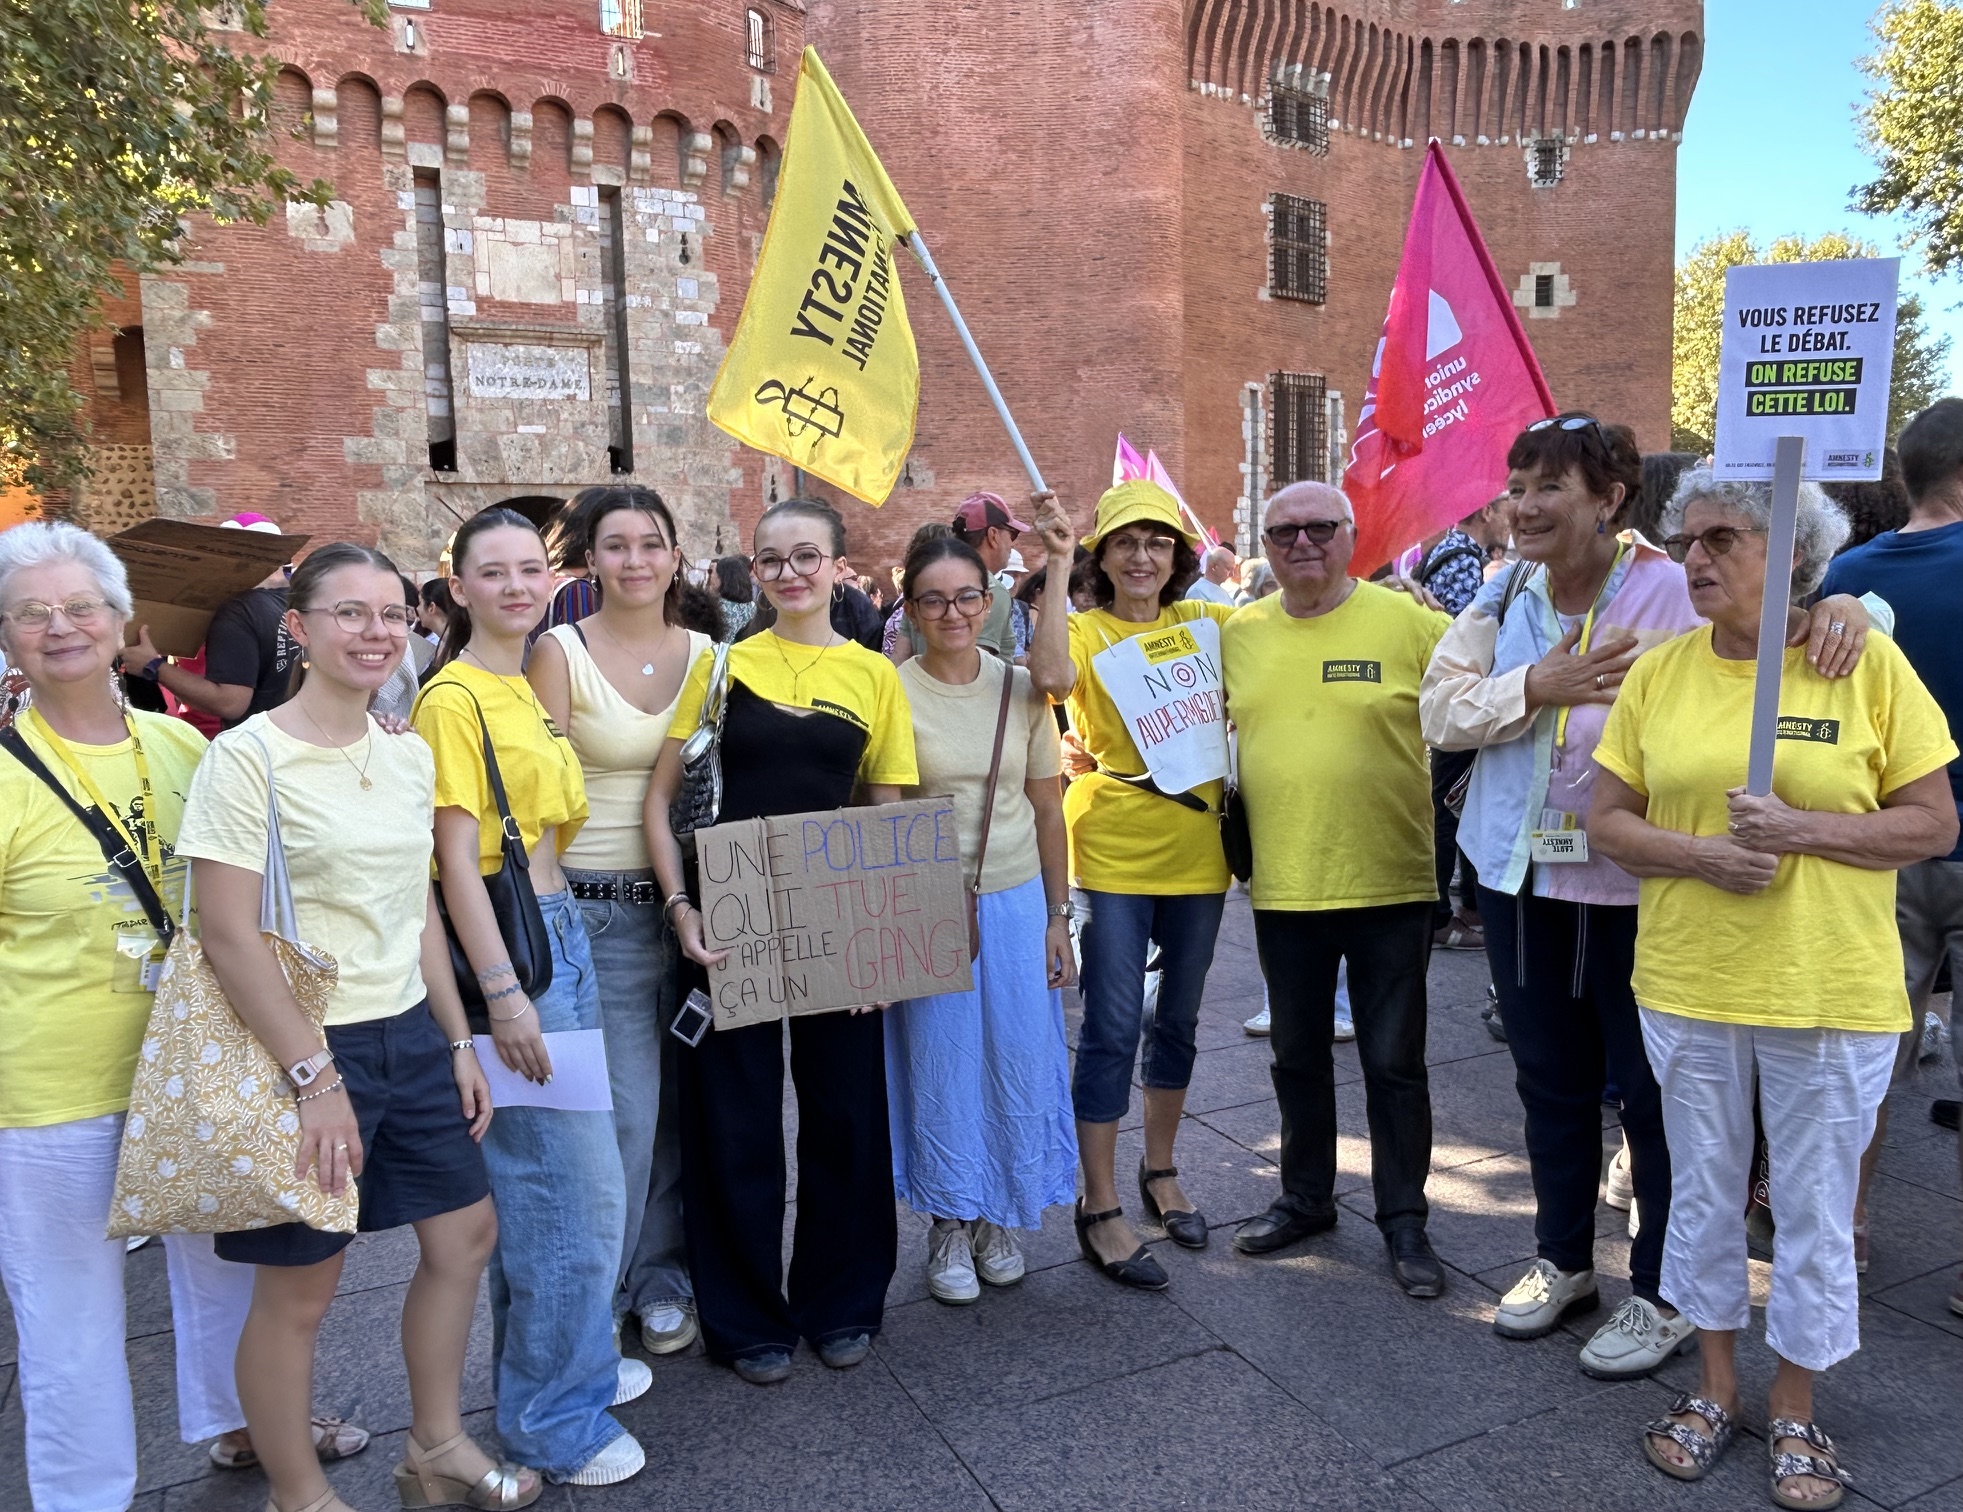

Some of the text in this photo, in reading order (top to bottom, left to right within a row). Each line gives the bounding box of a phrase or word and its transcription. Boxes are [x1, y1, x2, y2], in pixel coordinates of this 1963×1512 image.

[1738, 302, 1881, 328] VOUS REFUSEZ
[1760, 328, 1851, 354] LE DÉBAT.
[1751, 361, 1857, 384] ON REFUSE
[1752, 391, 1850, 413] CETTE LOI.
[1143, 635, 1176, 653] AMNESTY
[1143, 652, 1219, 699] NON
[1327, 664, 1361, 672] AMNESTY
[1136, 712, 1165, 750] AU
[704, 809, 959, 884] UNE POLICE
[710, 872, 922, 942] QUI TUE
[719, 919, 964, 1019] ÇA UN GANG
